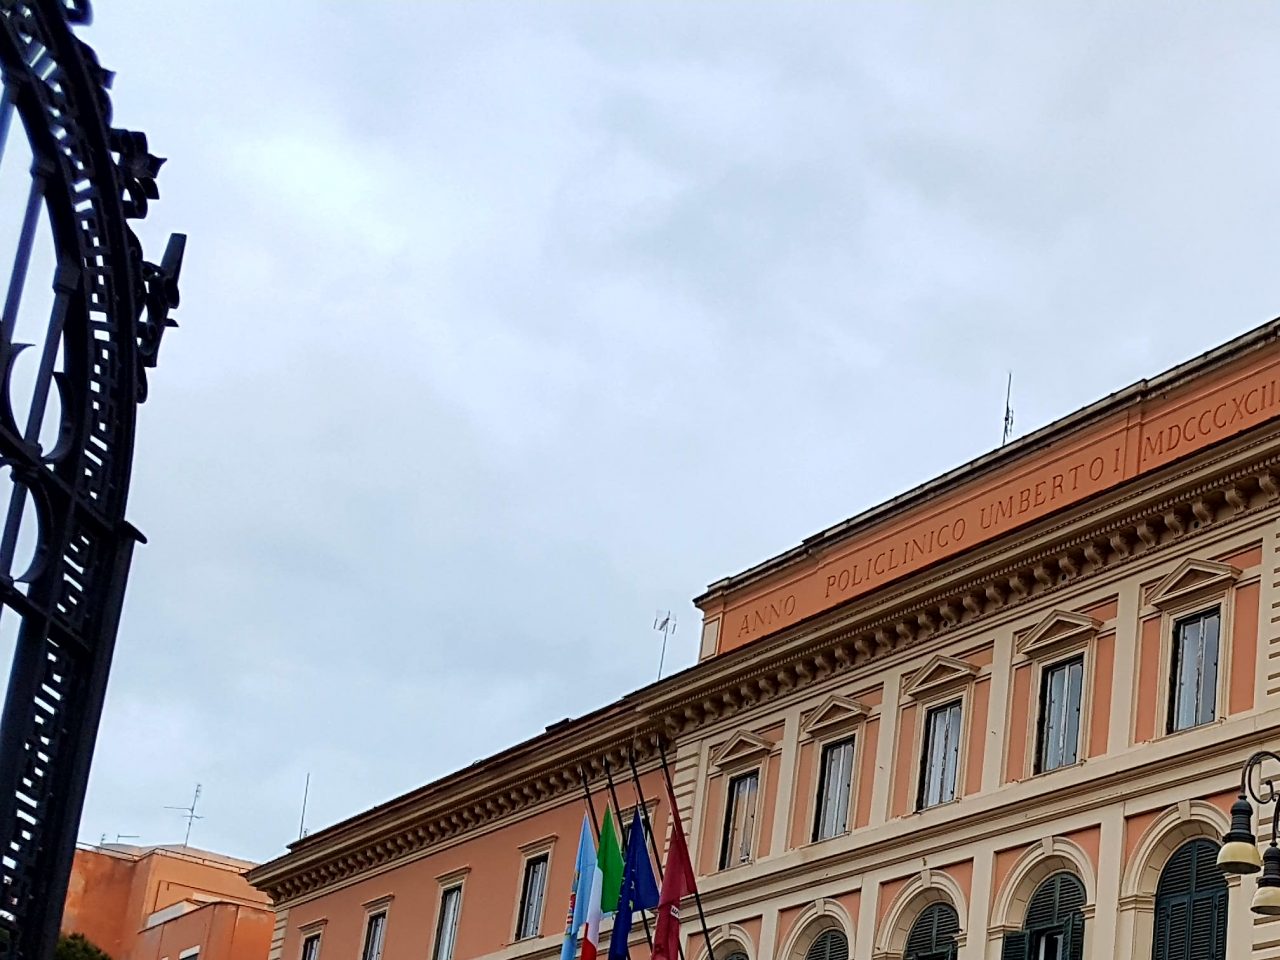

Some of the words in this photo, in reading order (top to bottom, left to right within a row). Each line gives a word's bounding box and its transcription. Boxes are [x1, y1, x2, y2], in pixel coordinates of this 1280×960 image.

[737, 594, 797, 639] ANNO
[824, 517, 967, 599] POLICLINICO
[979, 456, 1105, 530] UMBERTO
[1112, 447, 1121, 473] I
